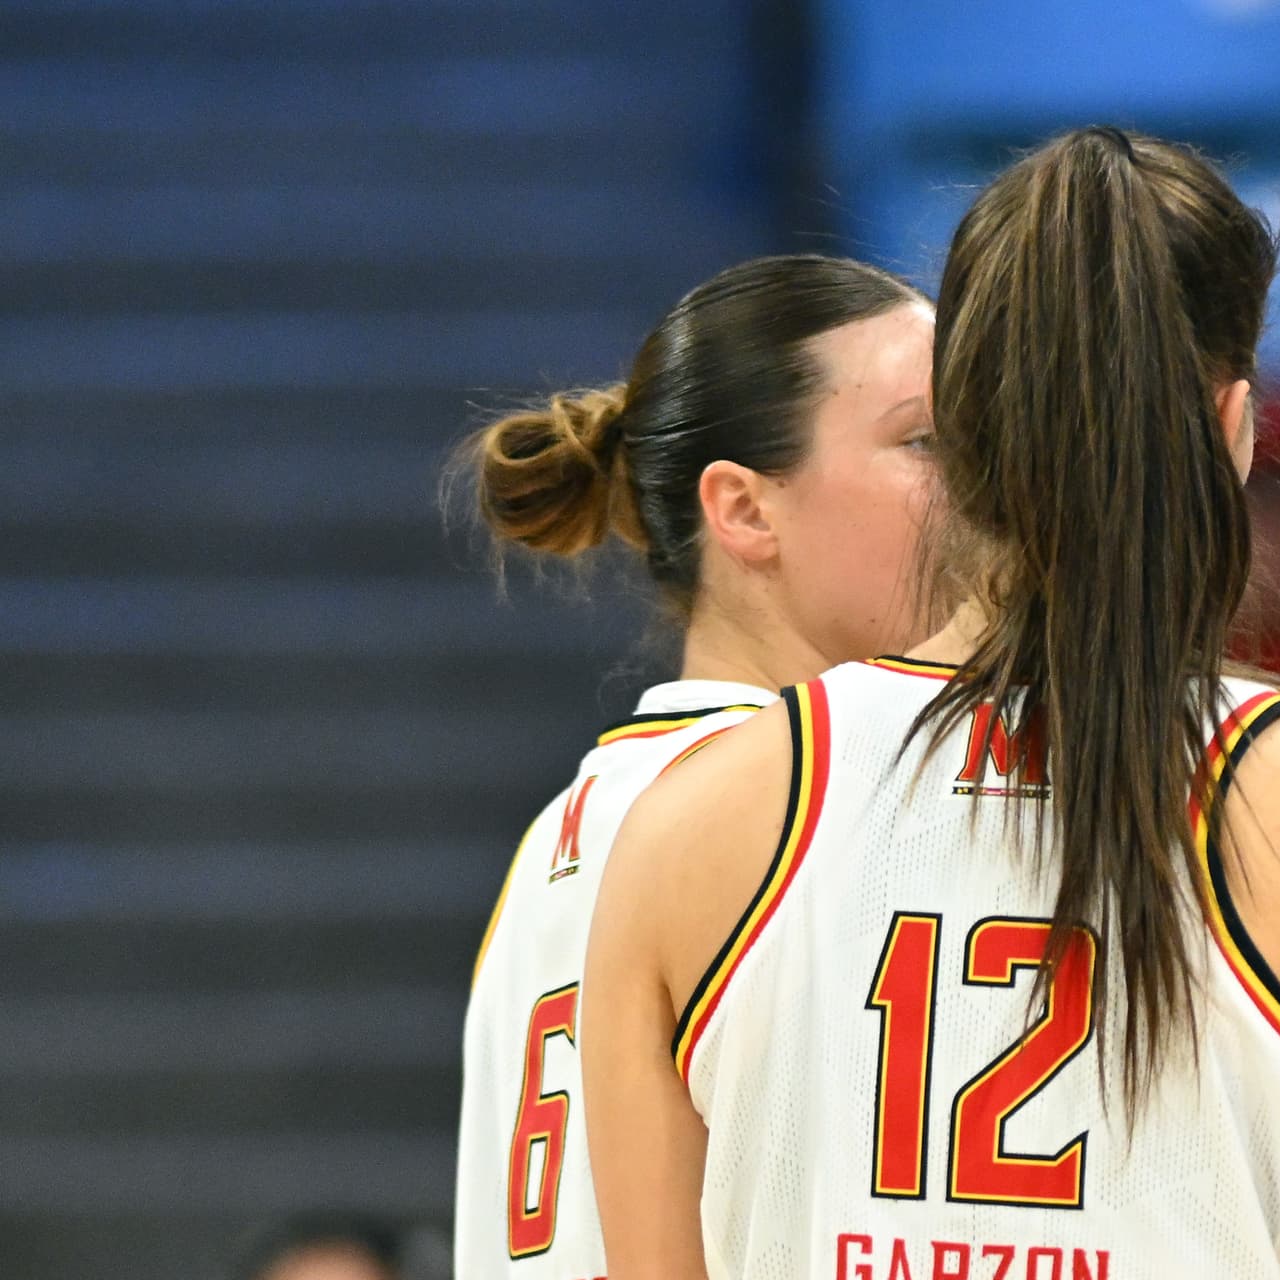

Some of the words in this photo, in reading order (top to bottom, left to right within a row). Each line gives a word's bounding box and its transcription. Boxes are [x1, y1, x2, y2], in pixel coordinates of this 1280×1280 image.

[551, 774, 599, 870] M
[955, 702, 1051, 785] M
[508, 981, 579, 1260] 6
[865, 911, 1098, 1210] 12
